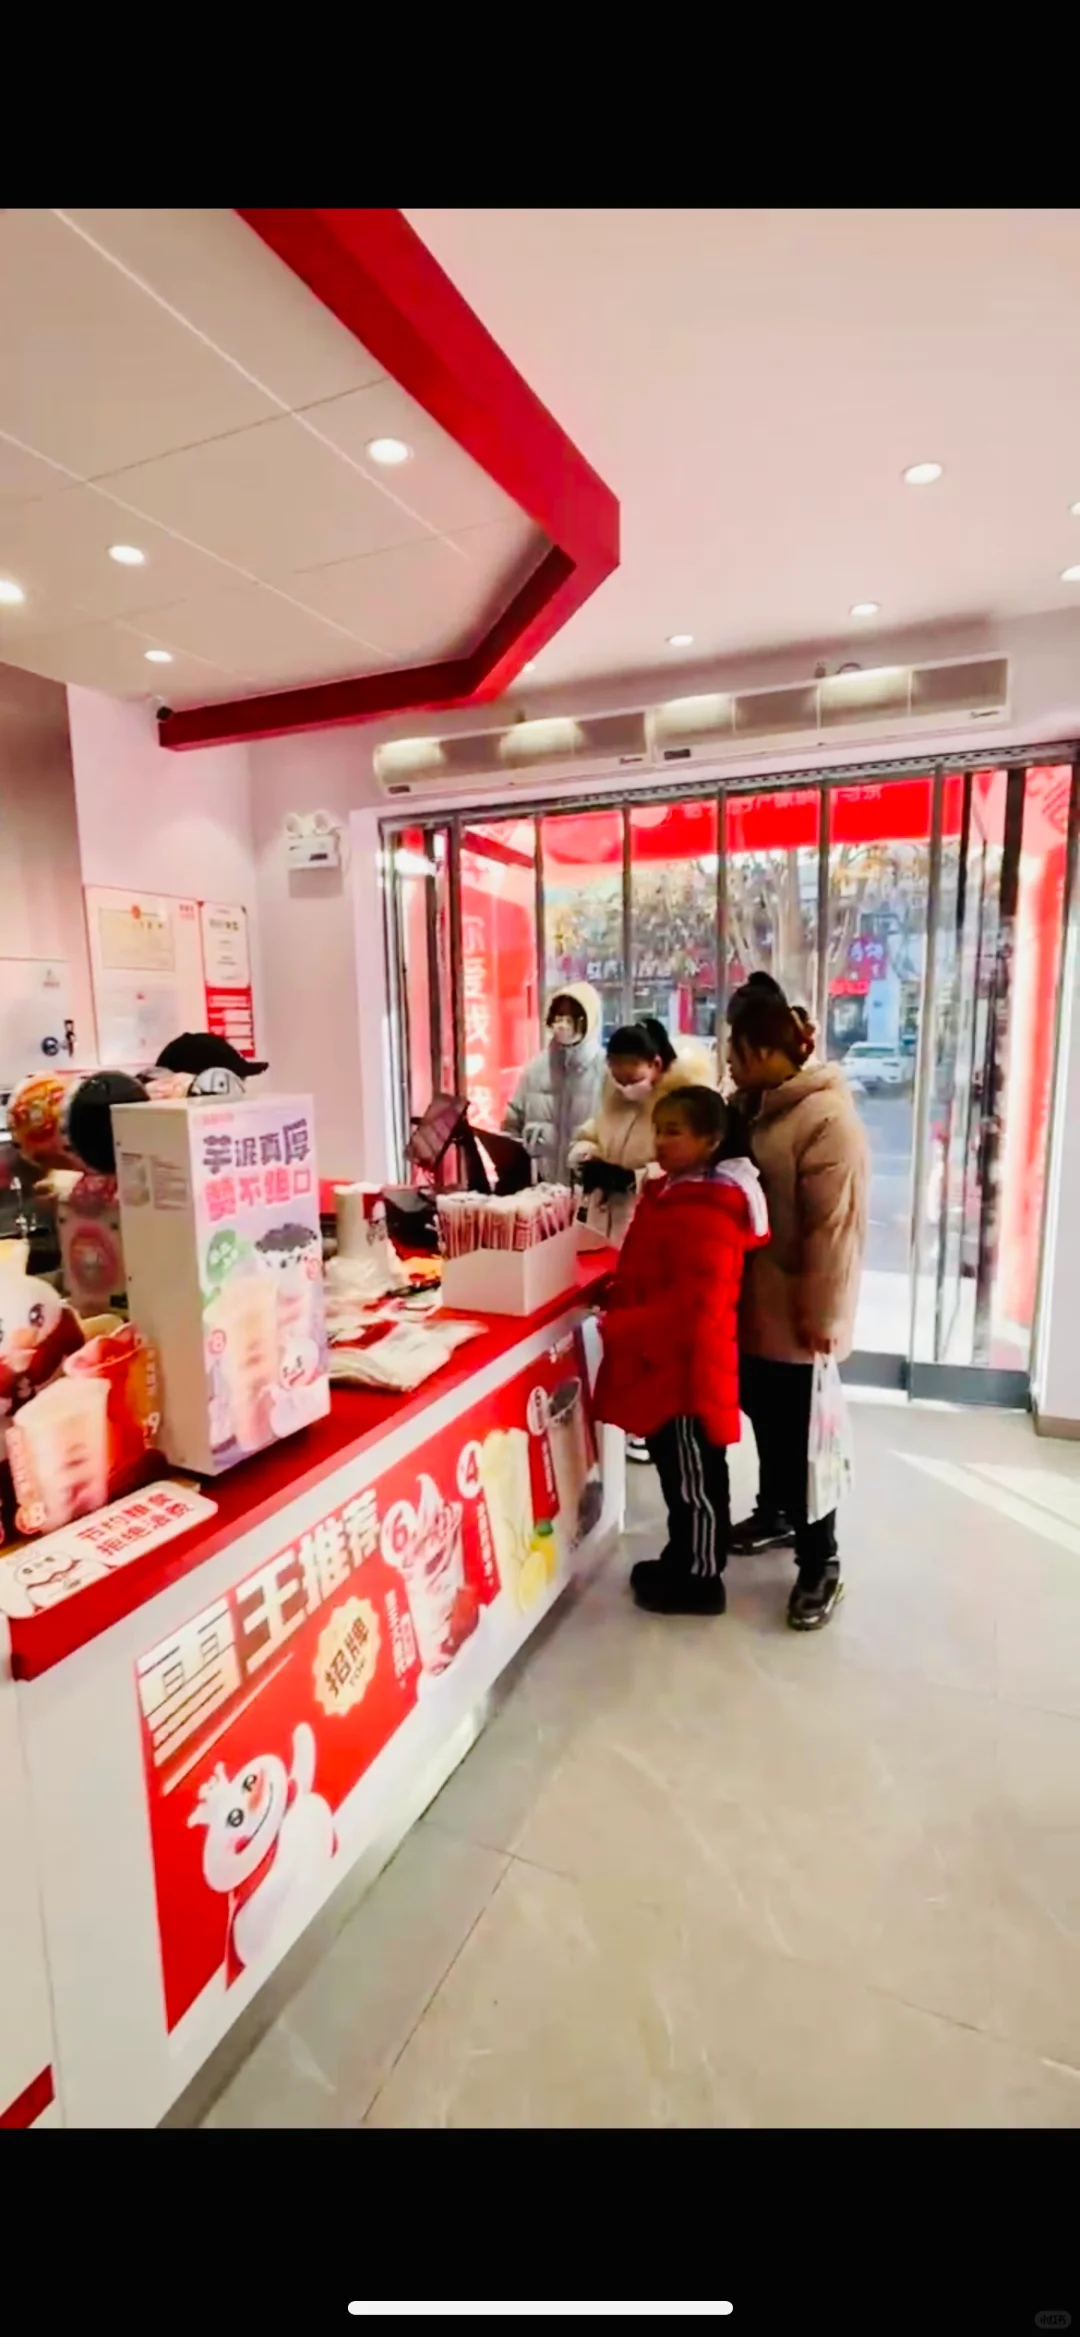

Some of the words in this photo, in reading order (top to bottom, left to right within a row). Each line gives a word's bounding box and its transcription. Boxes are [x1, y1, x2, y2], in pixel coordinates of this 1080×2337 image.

[202, 1118, 310, 1175] 芋泥真厚
[466, 1450, 478, 1484] 4
[392, 1513, 407, 1554] 6
[135, 1489, 382, 1770] 雪王推荐
[324, 1616, 369, 1698] 招牌
